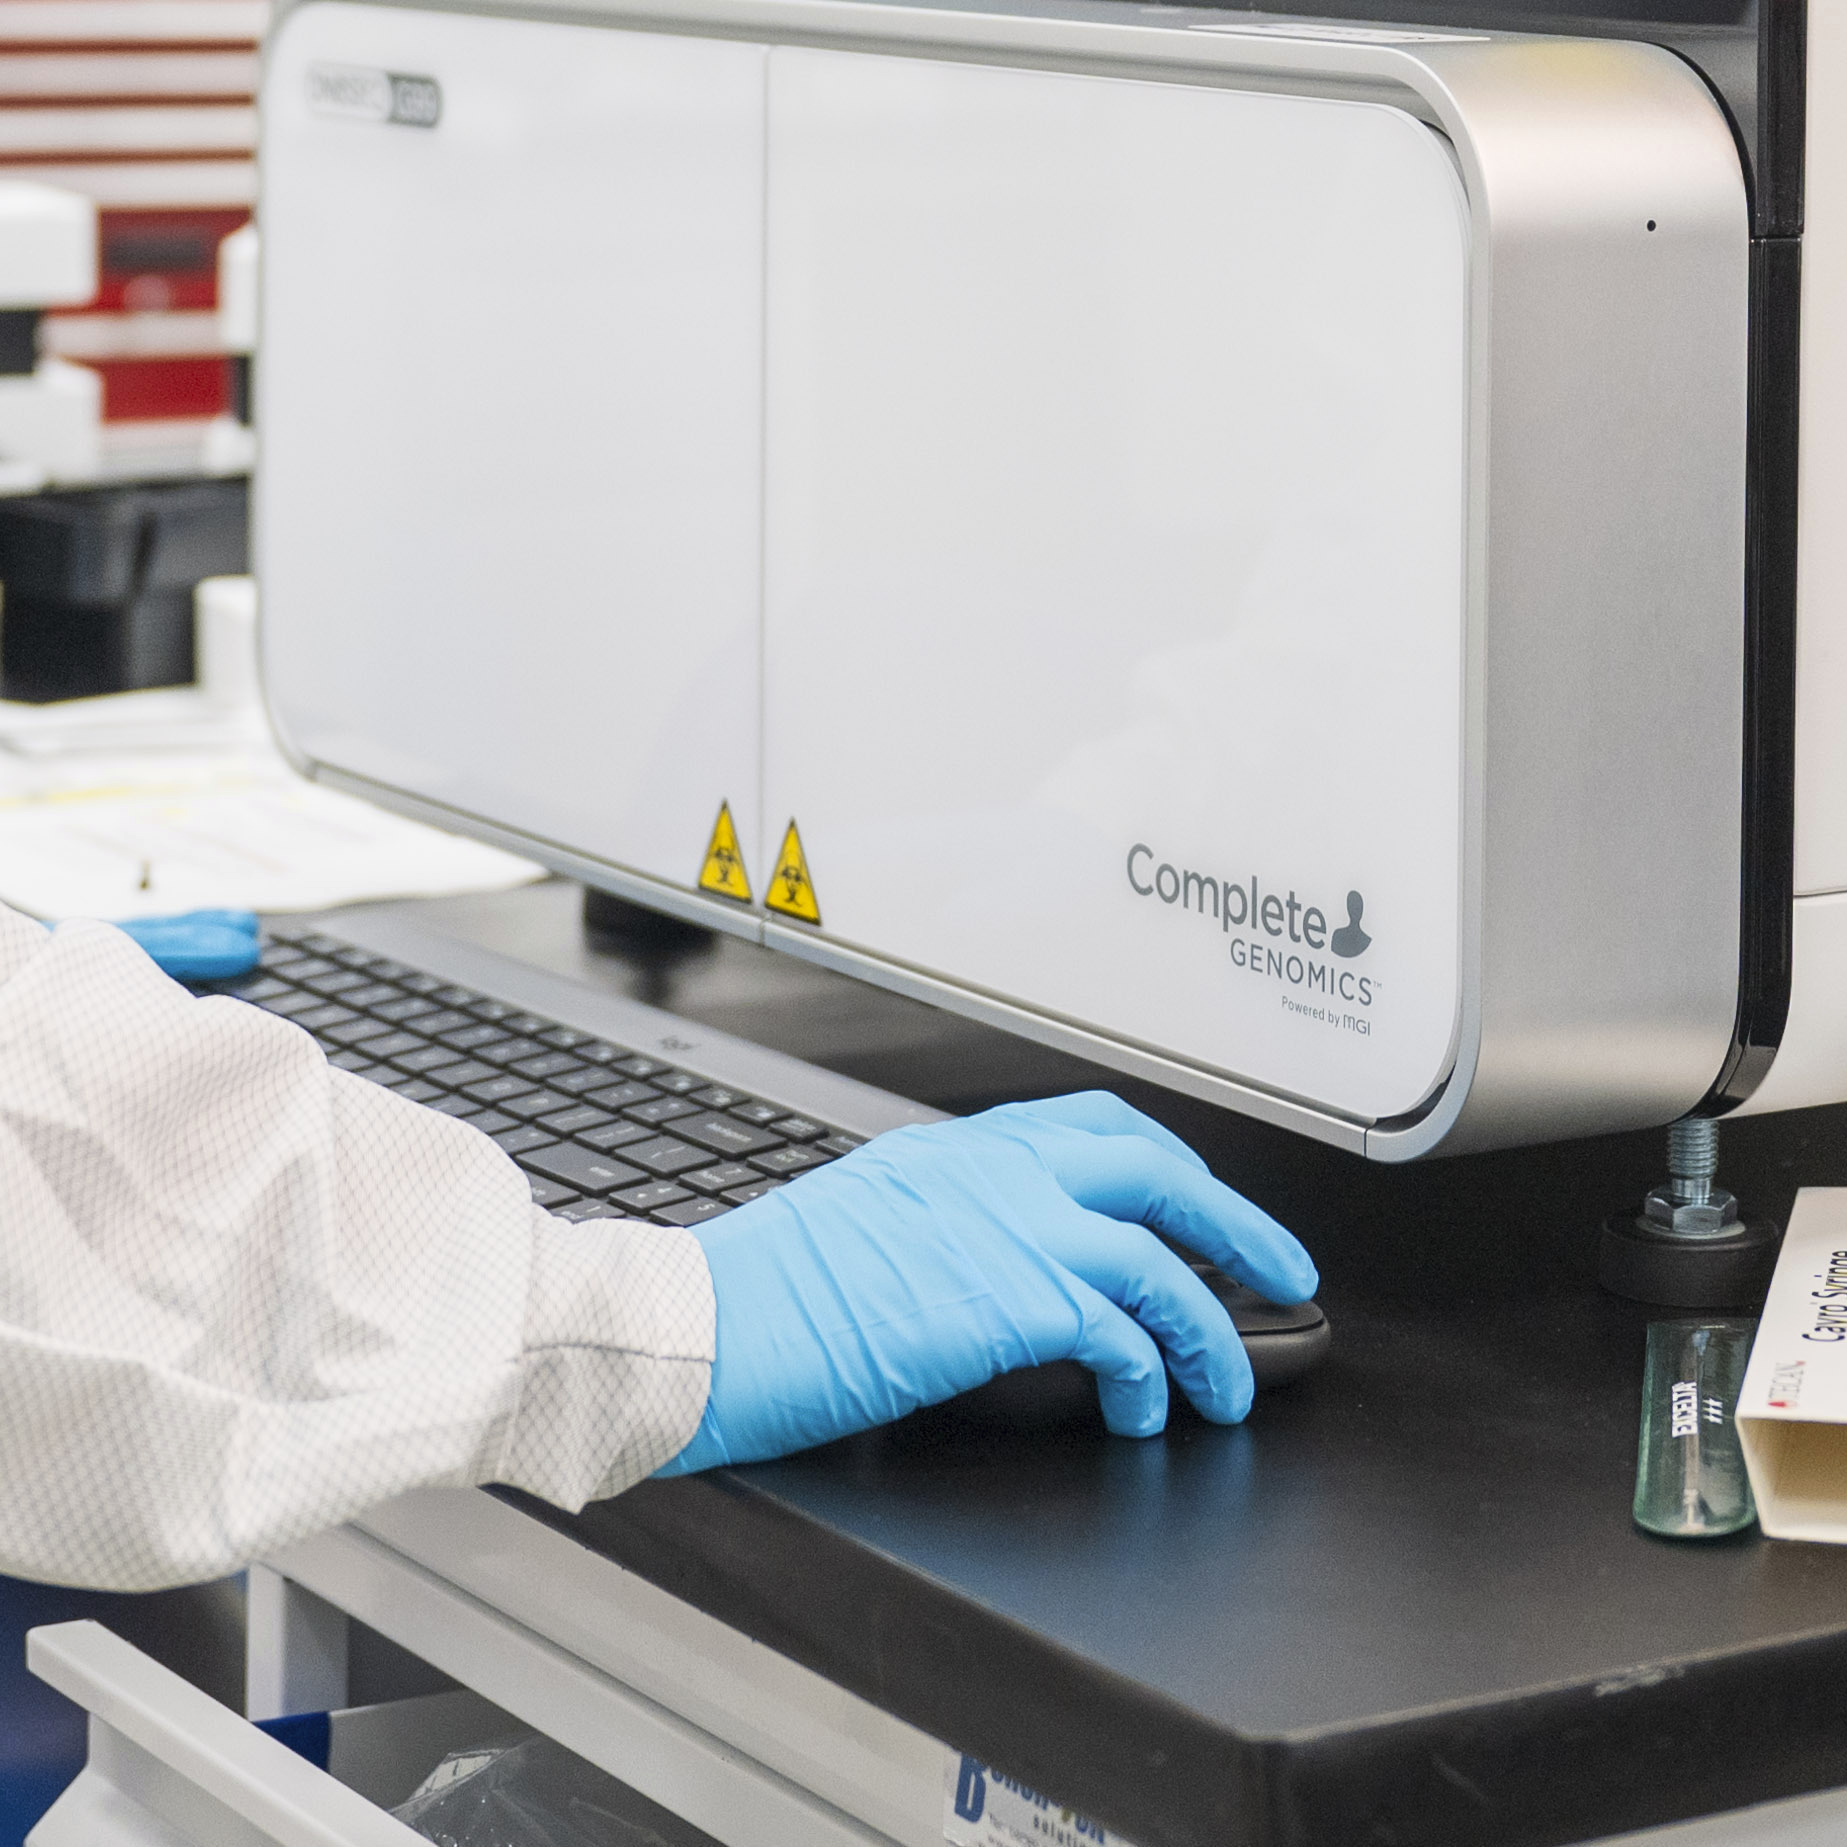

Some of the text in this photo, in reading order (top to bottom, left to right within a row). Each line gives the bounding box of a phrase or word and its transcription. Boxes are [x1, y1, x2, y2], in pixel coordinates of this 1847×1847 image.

[1126, 842, 1327, 950] Complete
[1282, 995, 1371, 1036] Powered by MGI
